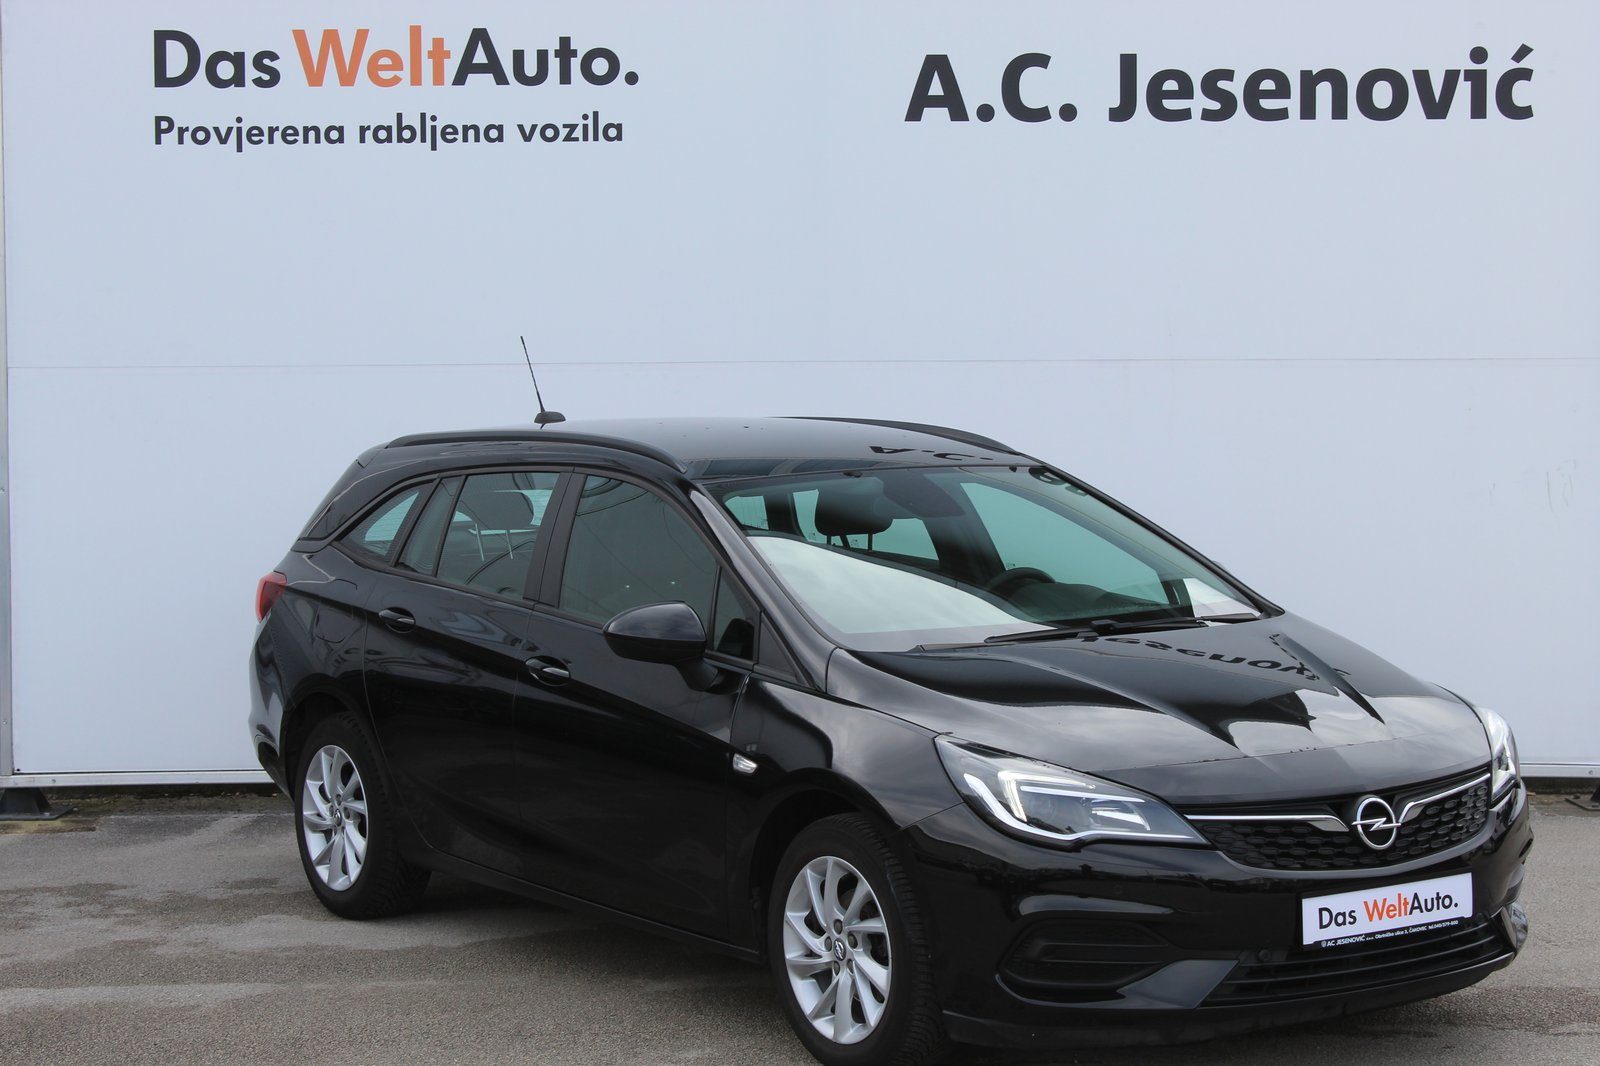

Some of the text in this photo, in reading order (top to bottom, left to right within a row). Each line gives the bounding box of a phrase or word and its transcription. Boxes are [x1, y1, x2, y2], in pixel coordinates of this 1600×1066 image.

[154, 25, 640, 89] Das WeltAuto.
[904, 43, 1535, 123] A.C. Jesenović
[154, 110, 623, 153] Provjerena rabljena vozila
[1318, 892, 1459, 930] Das WeltAuto.
